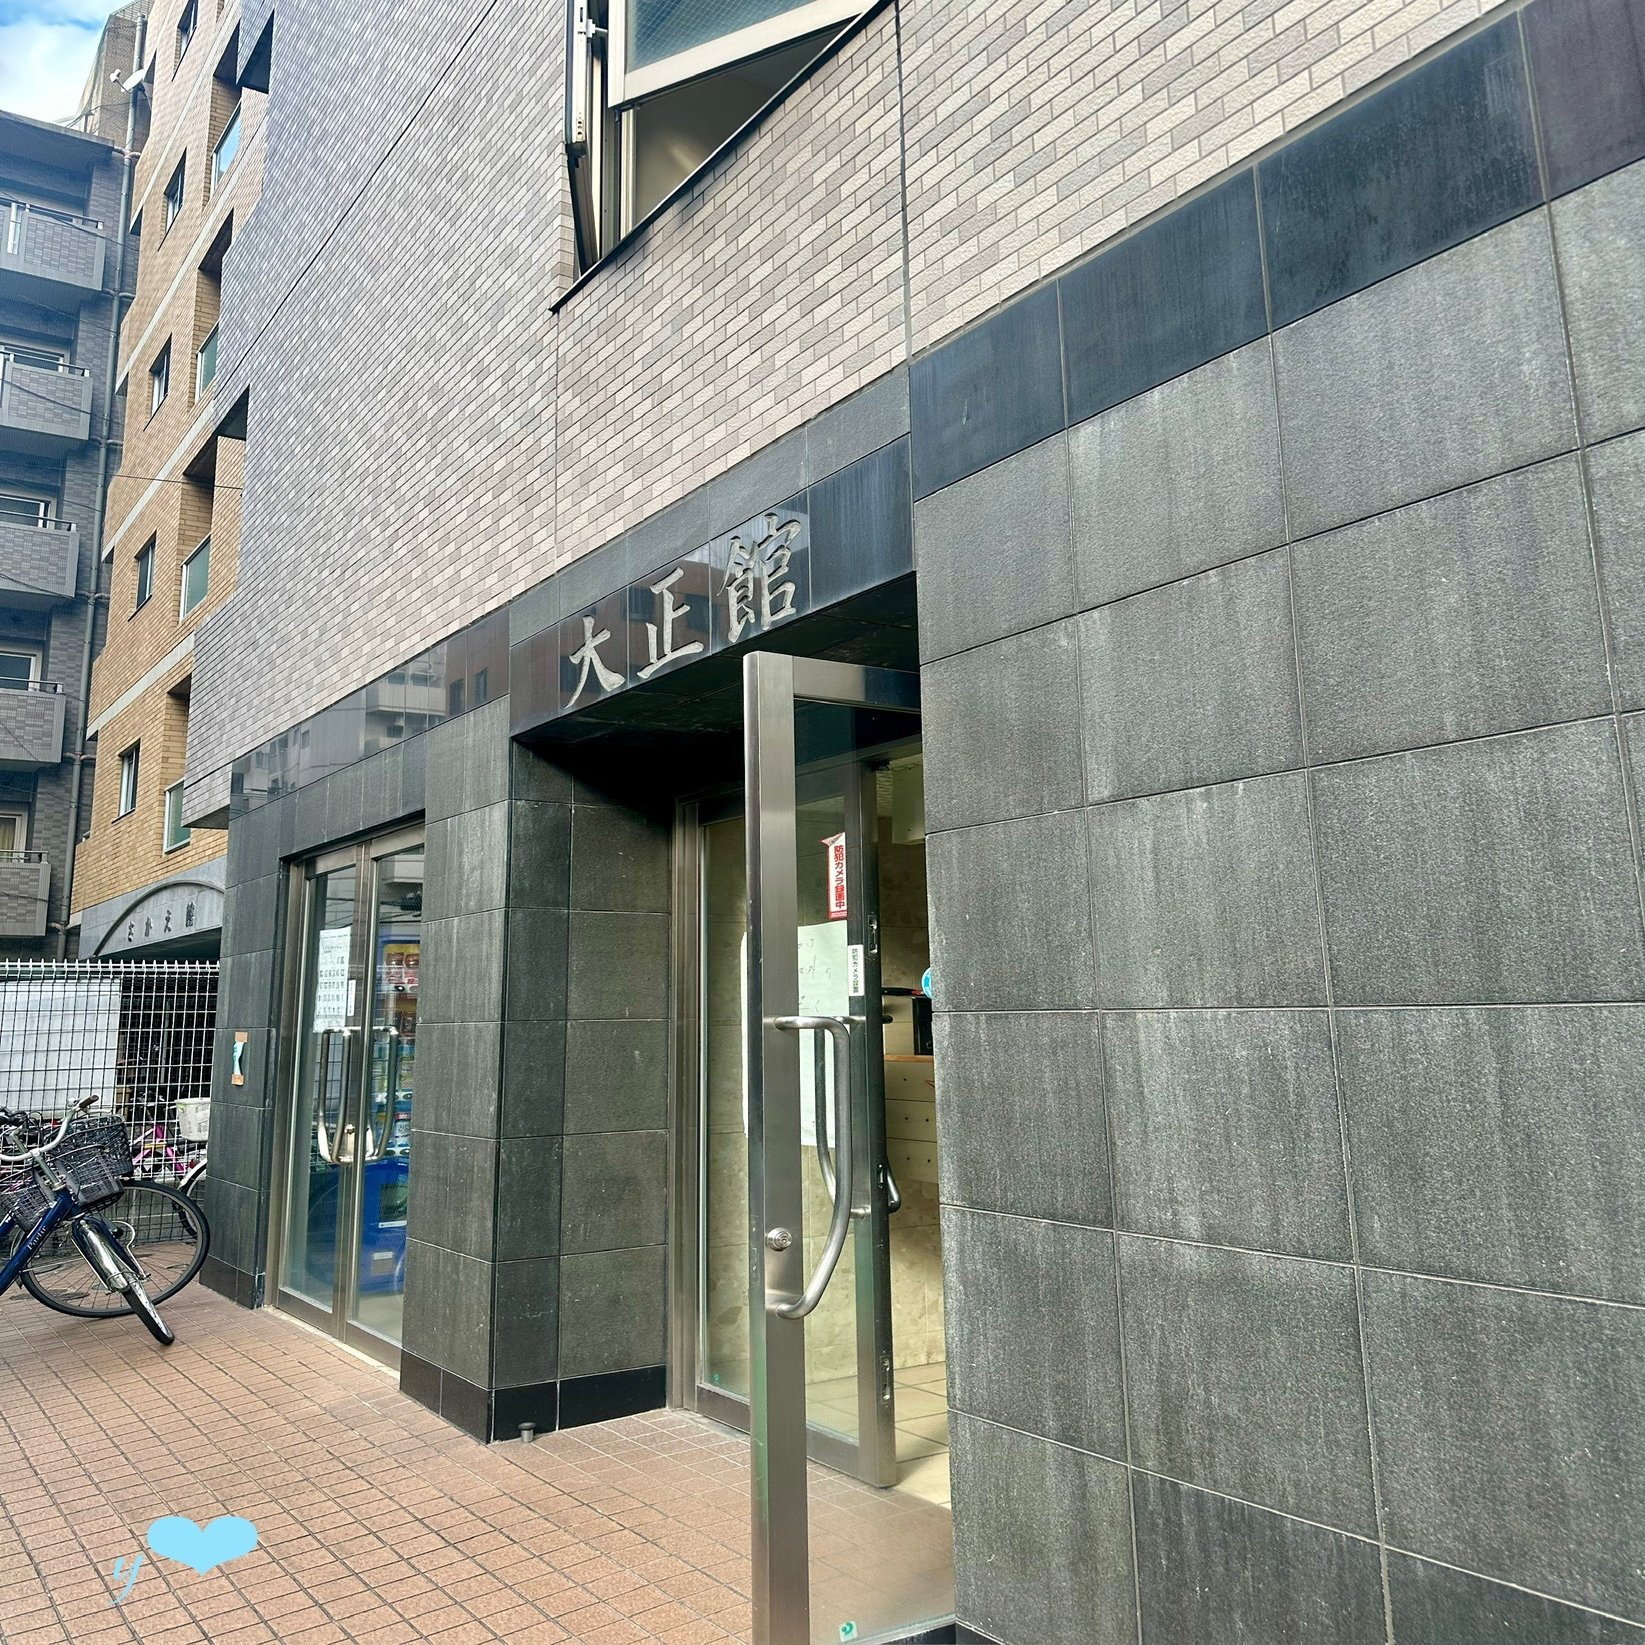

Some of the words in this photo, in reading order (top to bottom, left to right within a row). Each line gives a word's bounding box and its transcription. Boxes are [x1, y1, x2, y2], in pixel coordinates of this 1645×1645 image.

[564, 511, 802, 710] 大正館
[834, 845, 845, 908] 防犯カメラ録画中
